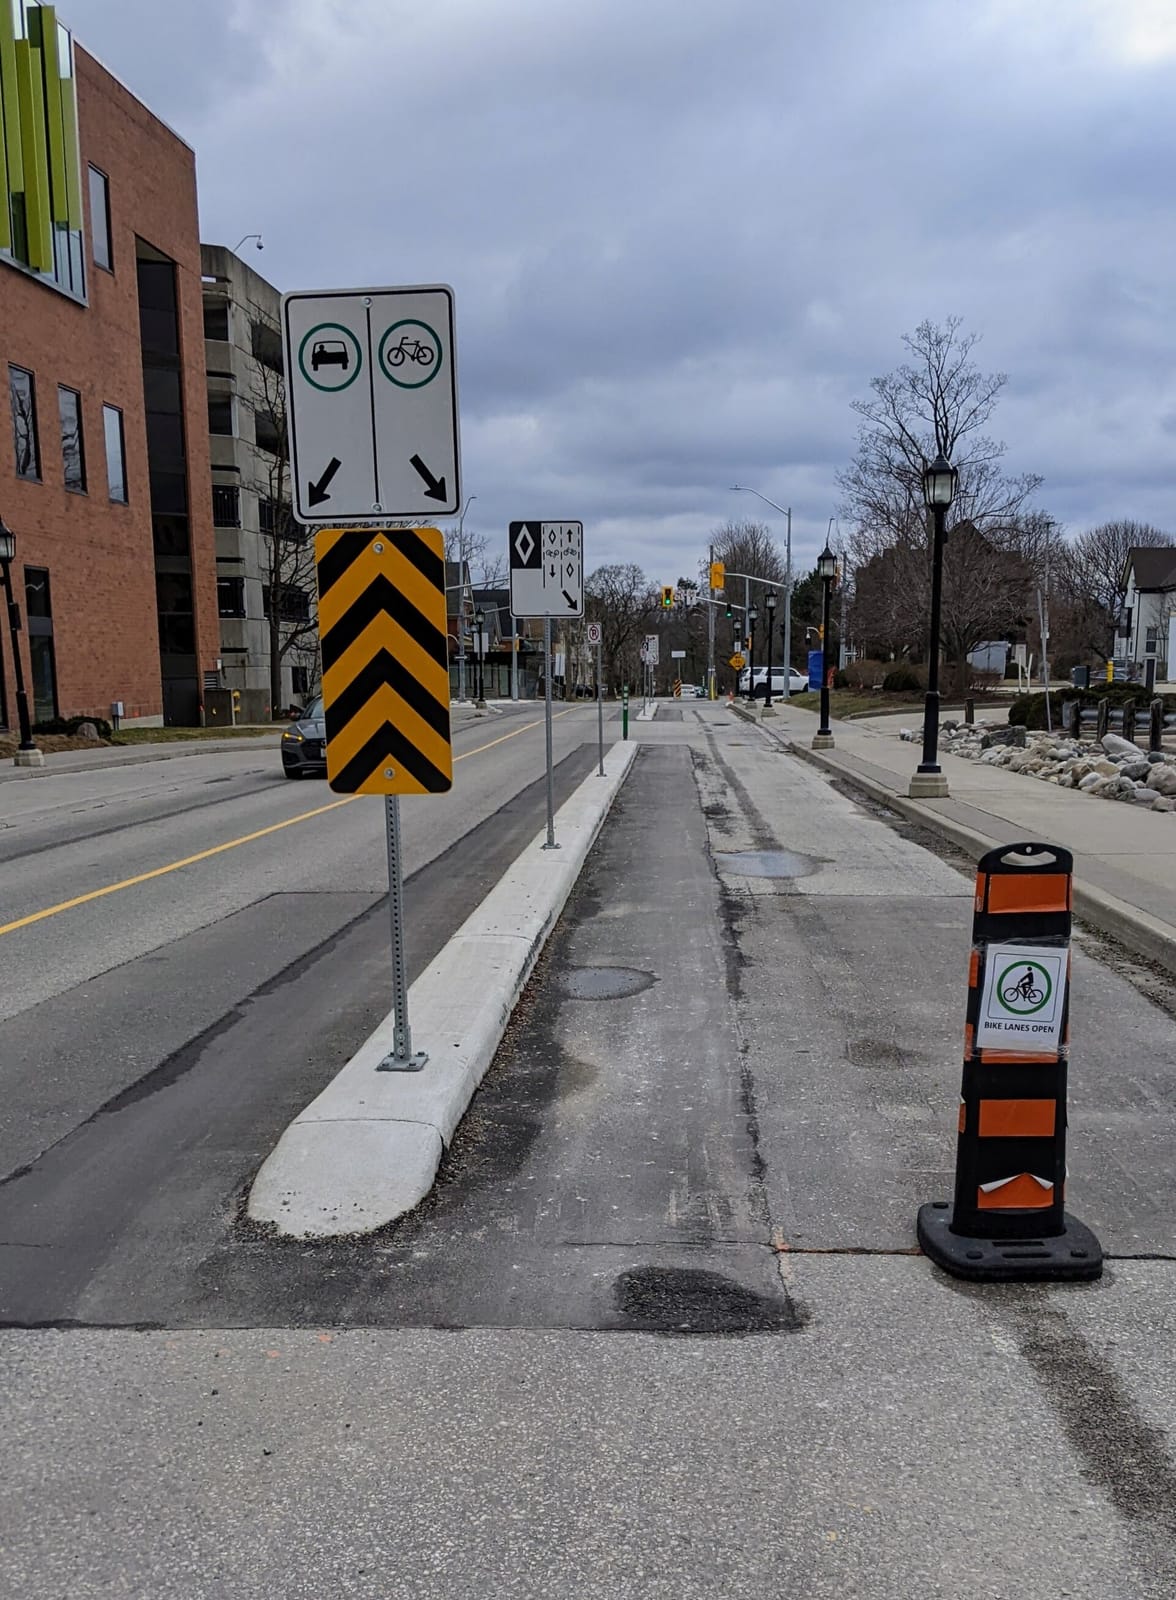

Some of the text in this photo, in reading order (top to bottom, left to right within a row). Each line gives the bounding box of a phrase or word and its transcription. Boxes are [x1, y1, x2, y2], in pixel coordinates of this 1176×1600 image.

[984, 1021, 1054, 1033] BIKE LANES OPEN
